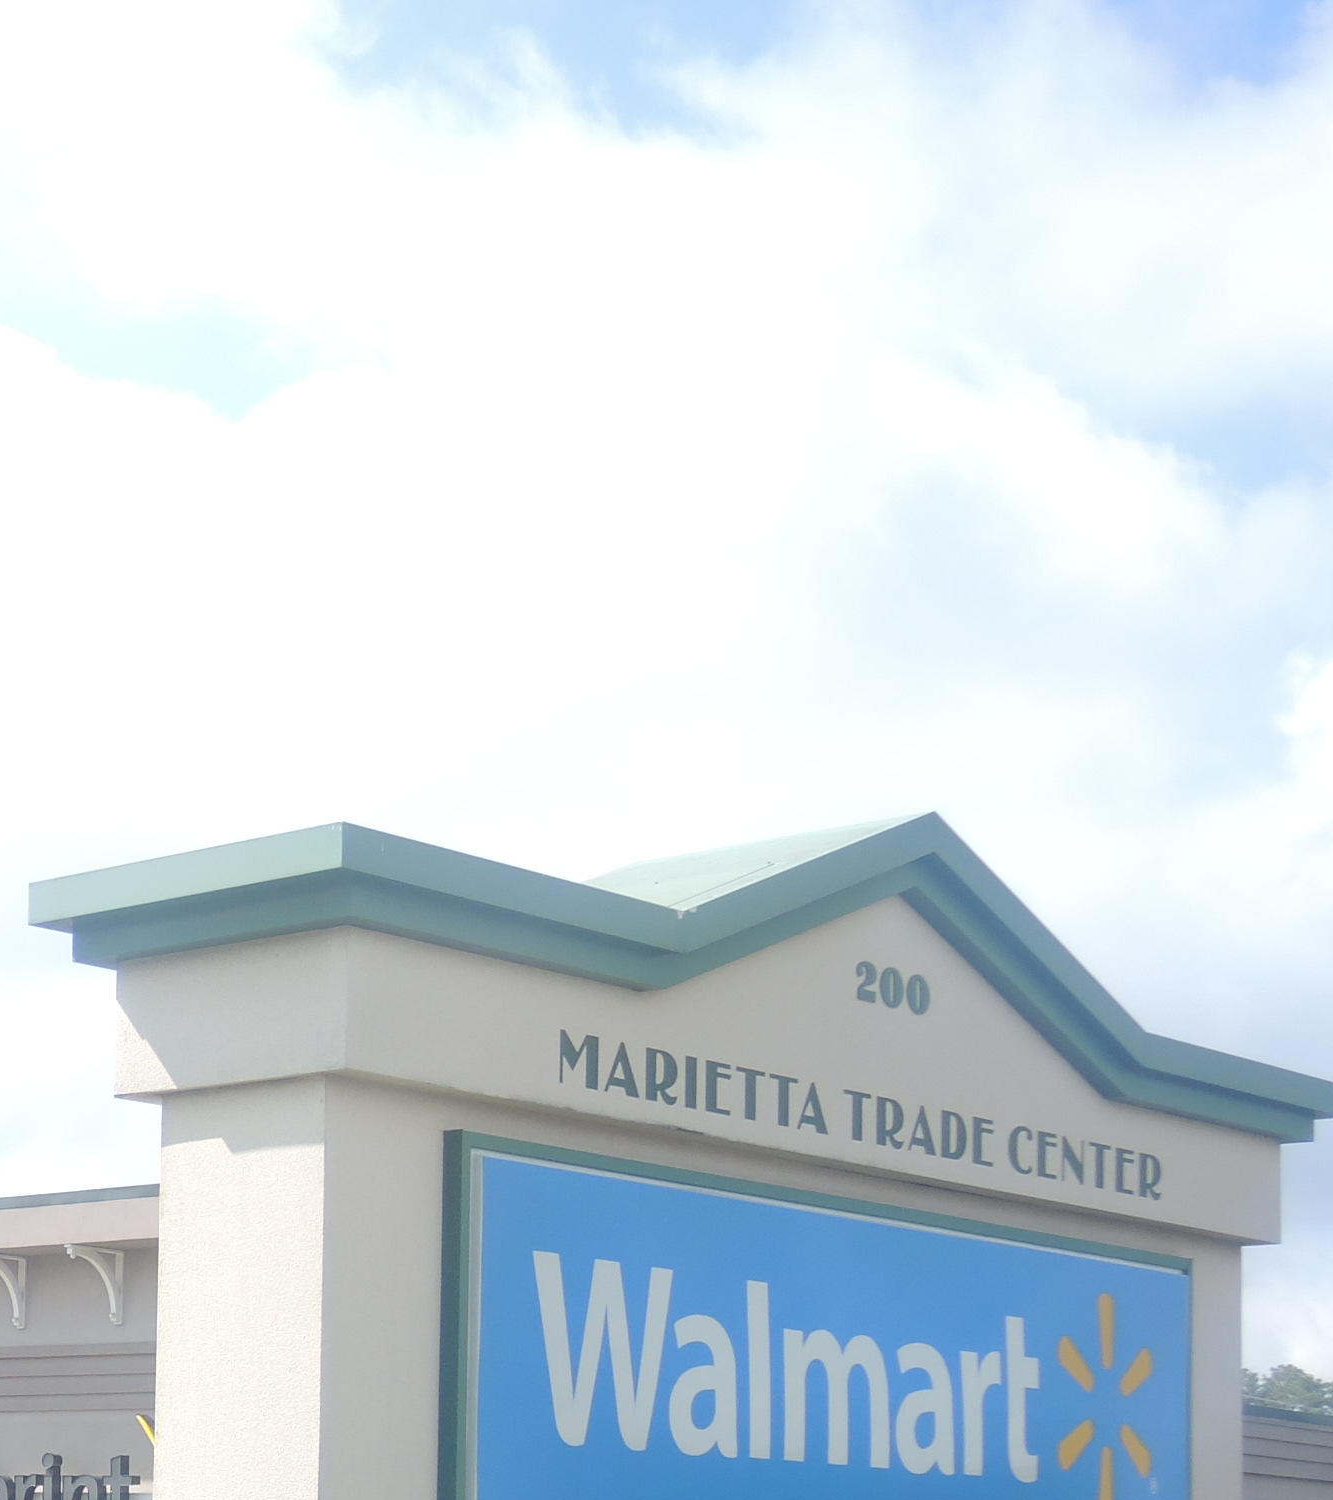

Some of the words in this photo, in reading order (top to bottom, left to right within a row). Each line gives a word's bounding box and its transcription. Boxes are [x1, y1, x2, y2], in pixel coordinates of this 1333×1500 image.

[856, 960, 931, 1016] 200
[558, 1028, 829, 1136] MARIETTA
[843, 1088, 995, 1167] TRADE
[1006, 1124, 1162, 1201] CENTER
[532, 1250, 1041, 1484] Walmart
